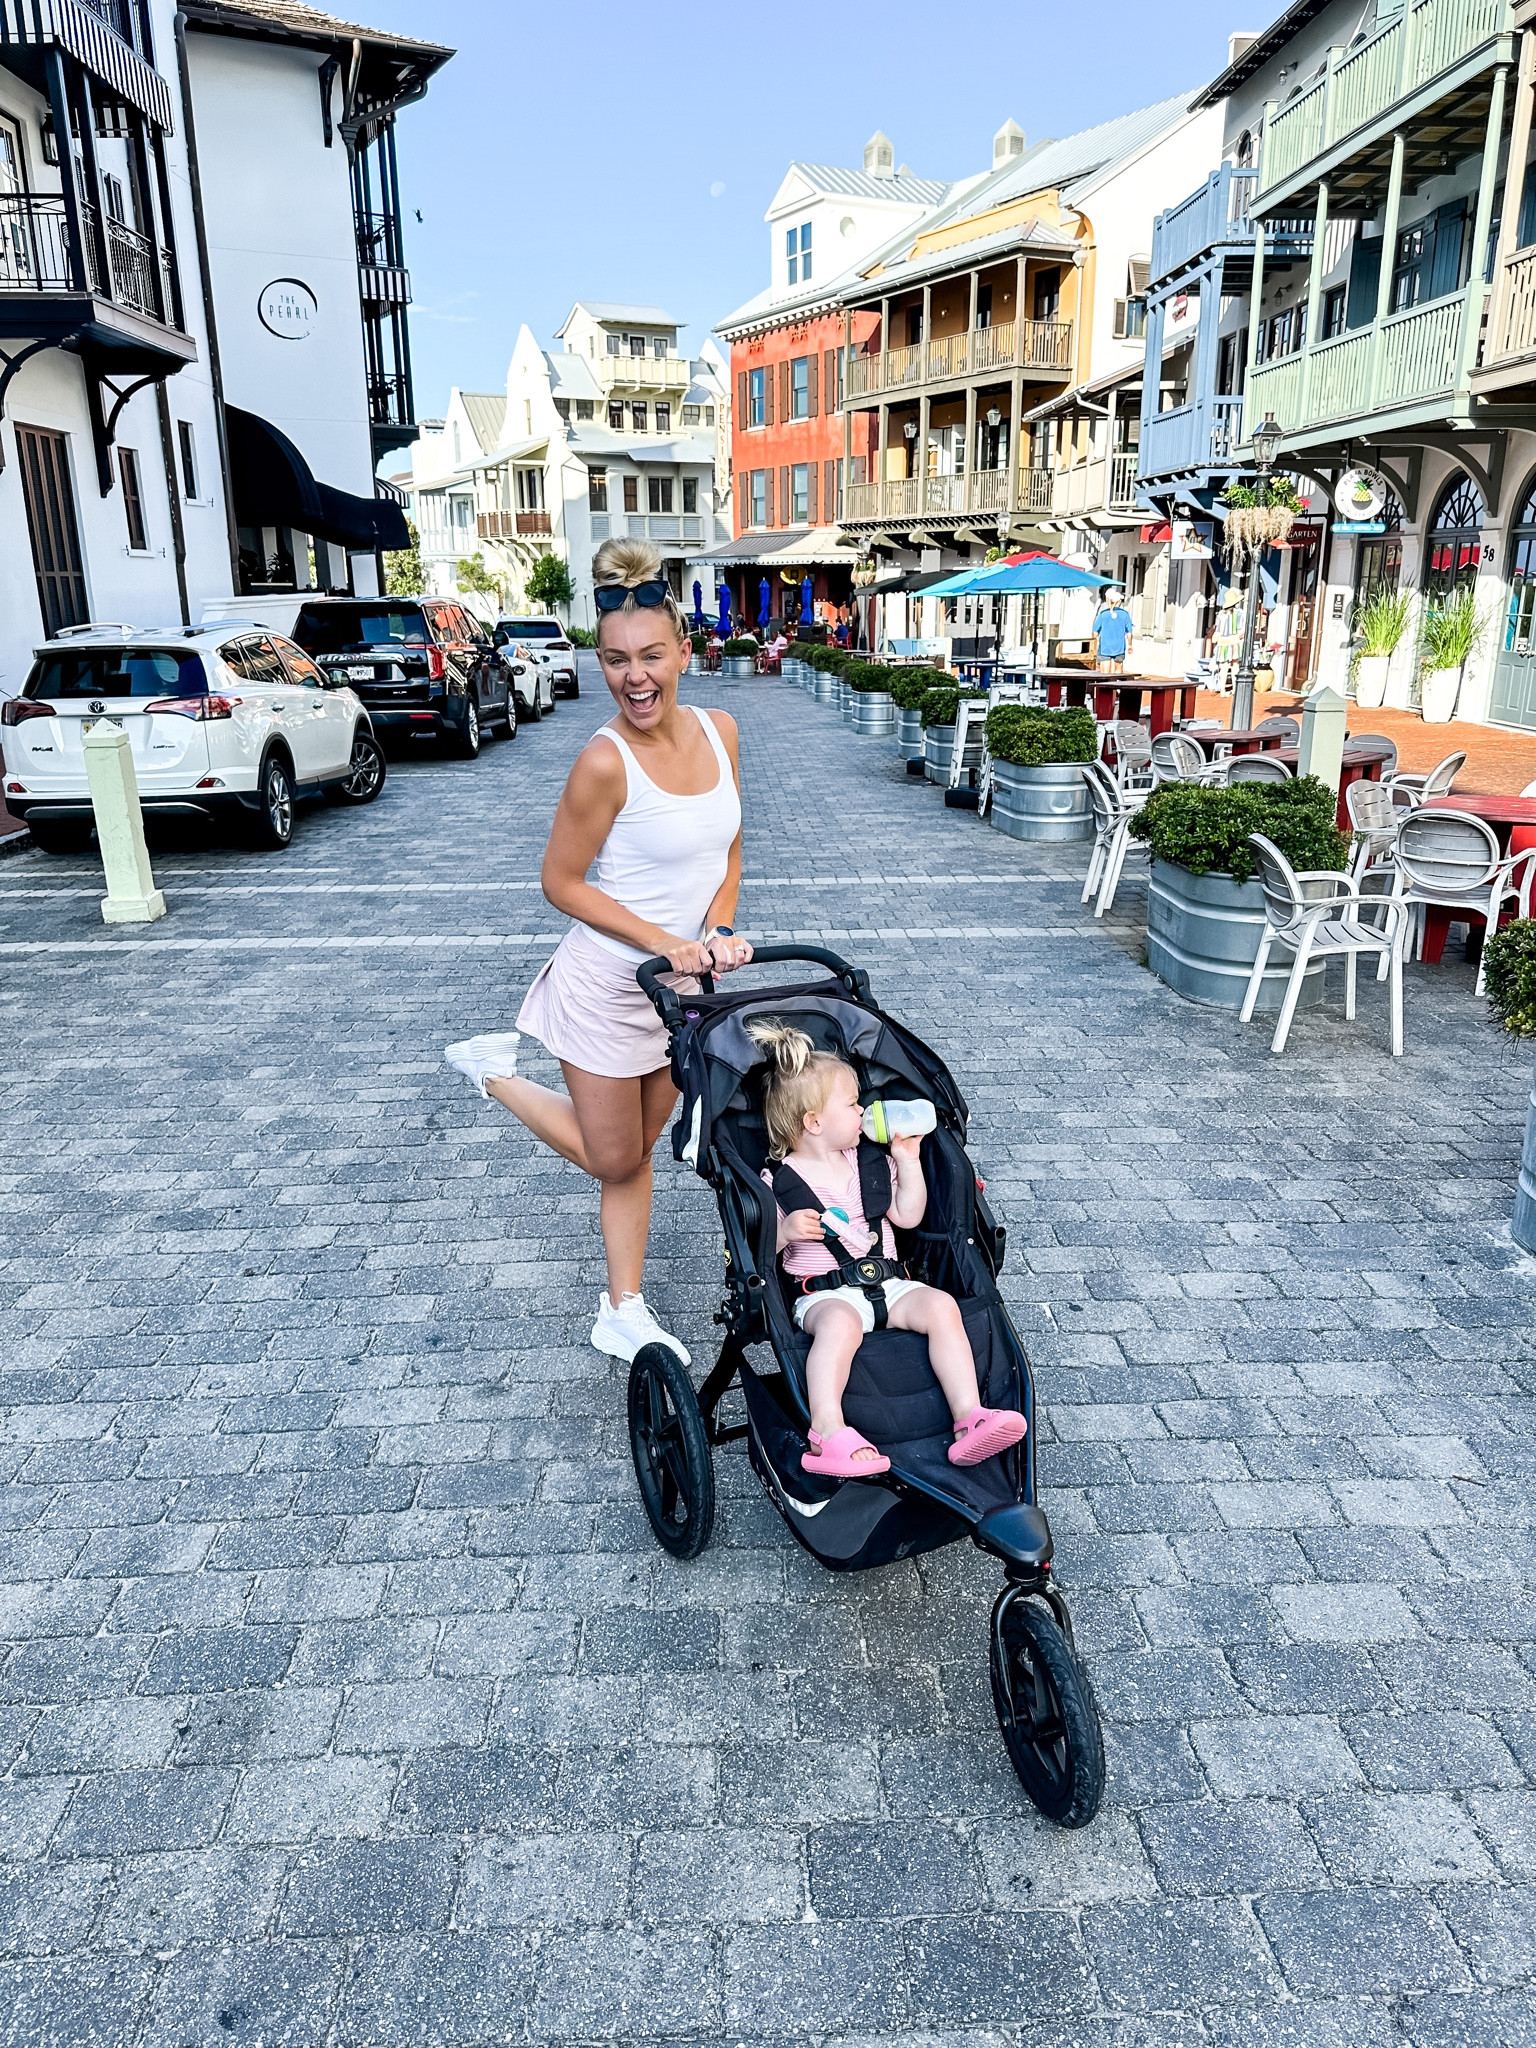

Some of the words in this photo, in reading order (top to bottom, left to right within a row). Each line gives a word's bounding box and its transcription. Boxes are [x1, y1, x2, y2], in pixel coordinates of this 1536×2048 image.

[280, 294, 295, 305] THE
[269, 304, 309, 321] PEARL
[1363, 469, 1383, 486] BOWLS
[1286, 530, 1318, 539] GARTEN
[1482, 544, 1495, 562] 58
